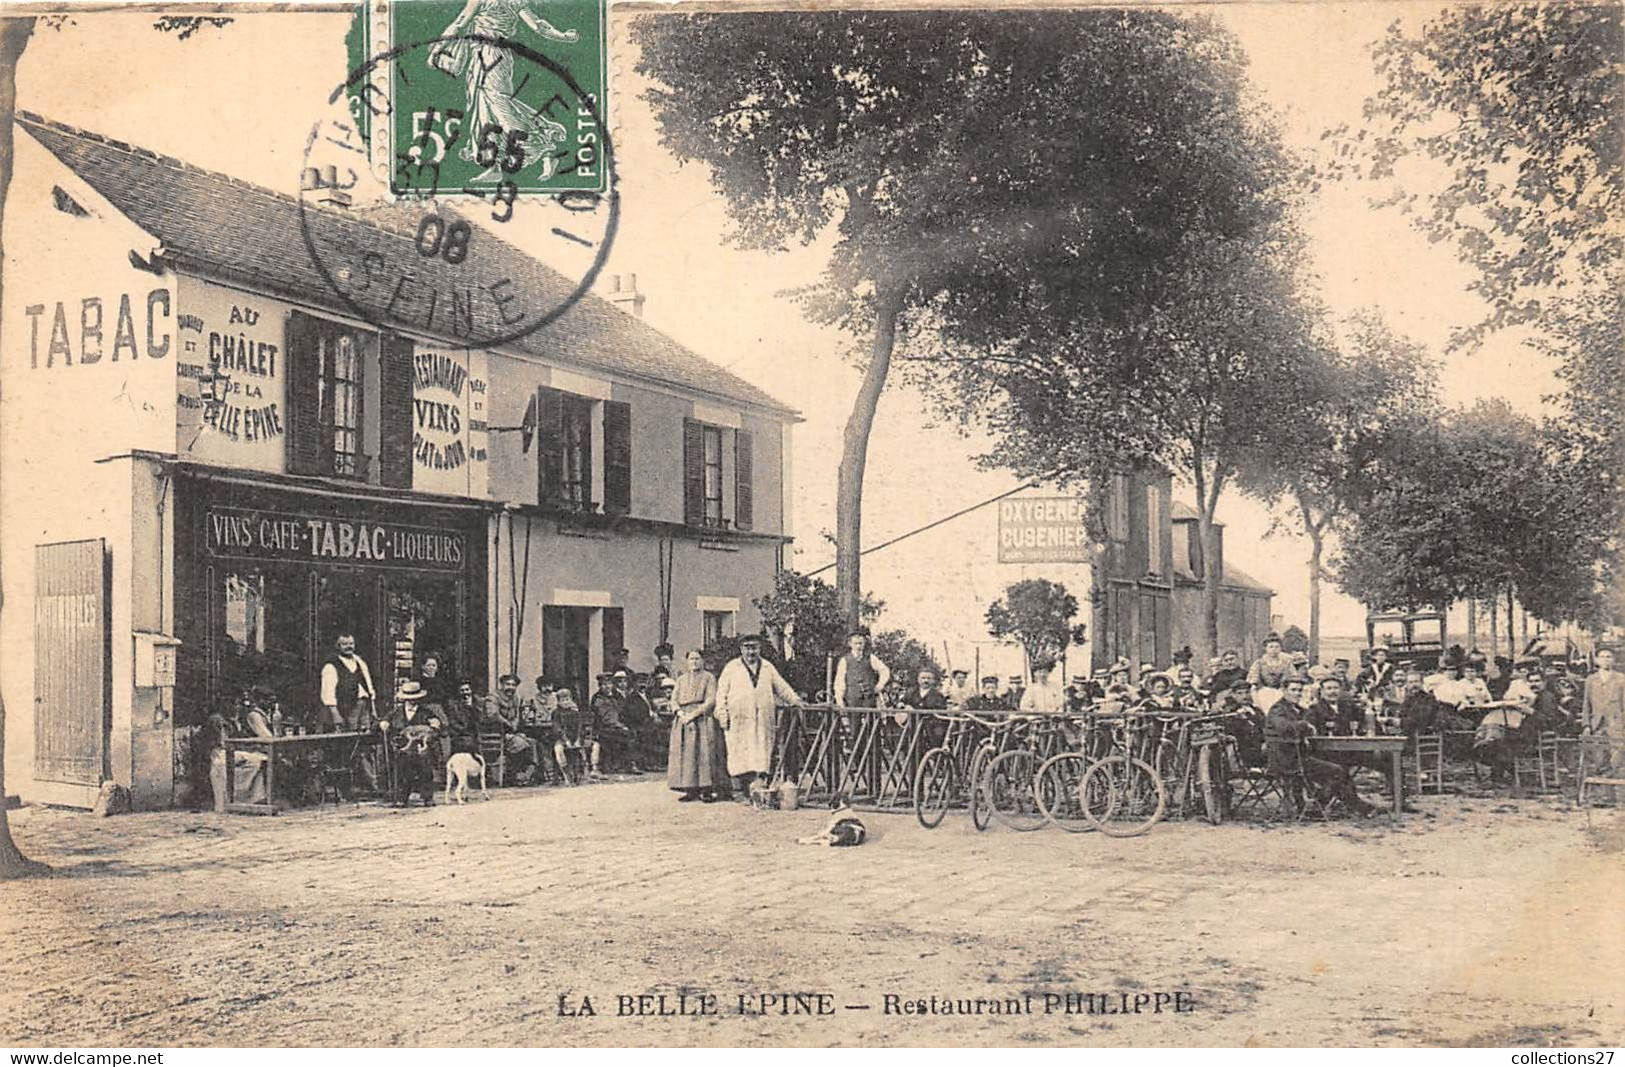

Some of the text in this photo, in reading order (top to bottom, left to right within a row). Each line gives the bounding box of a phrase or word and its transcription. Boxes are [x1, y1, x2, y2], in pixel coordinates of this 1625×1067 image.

[416, 213, 472, 264] 08
[229, 305, 260, 326] AU
[350, 250, 525, 338] SEINE
[25, 288, 171, 369] TABAC
[209, 331, 278, 378] CHÂLET
[245, 384, 262, 399] LA
[413, 398, 460, 435] VINS
[212, 515, 252, 547] VINS
[307, 520, 386, 560] TABAC
[392, 531, 461, 562] LIQUEURS
